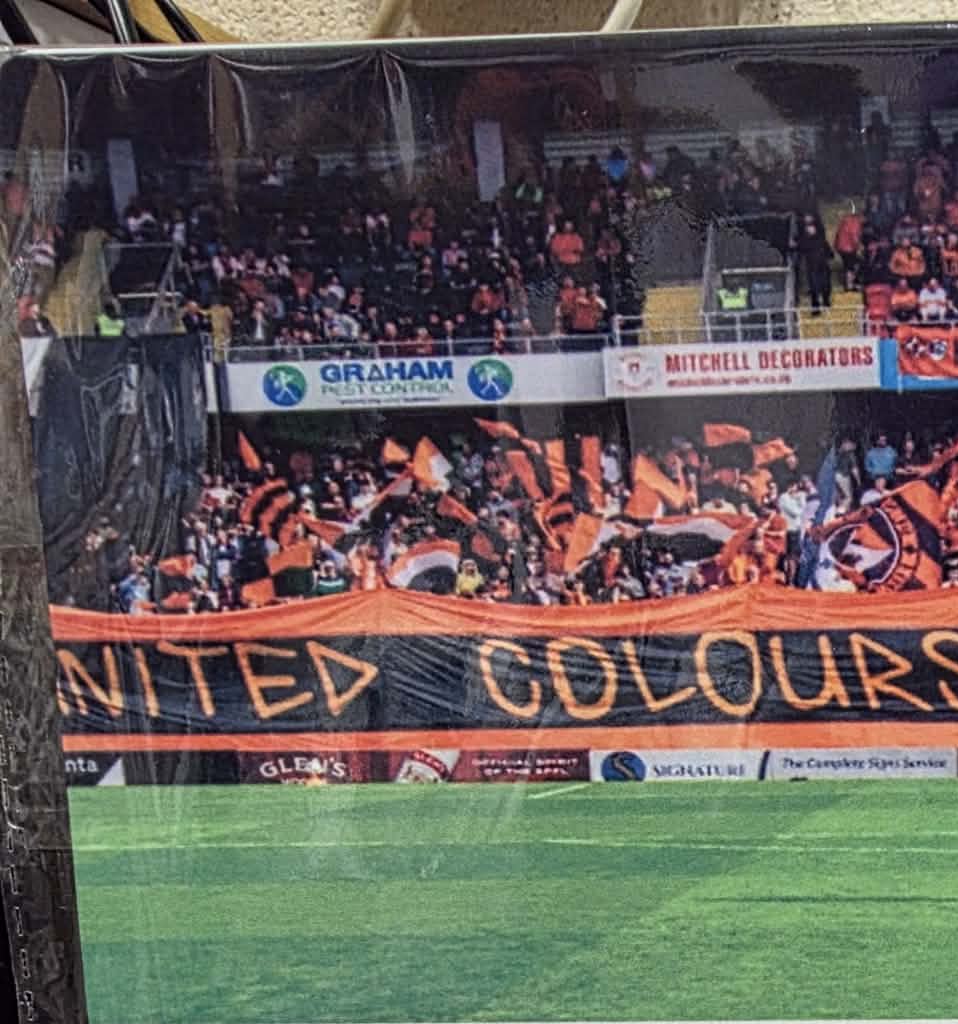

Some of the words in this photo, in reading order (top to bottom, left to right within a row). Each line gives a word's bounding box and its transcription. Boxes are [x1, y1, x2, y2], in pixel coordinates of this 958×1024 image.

[665, 352, 750, 373] MITCHELL
[759, 346, 873, 369] DECORATORS
[320, 360, 454, 383] GRAHAM
[321, 383, 367, 395] PEST
[371, 381, 454, 395] CONTROL
[57, 639, 378, 720] NITED
[259, 757, 347, 778] GLEN'S
